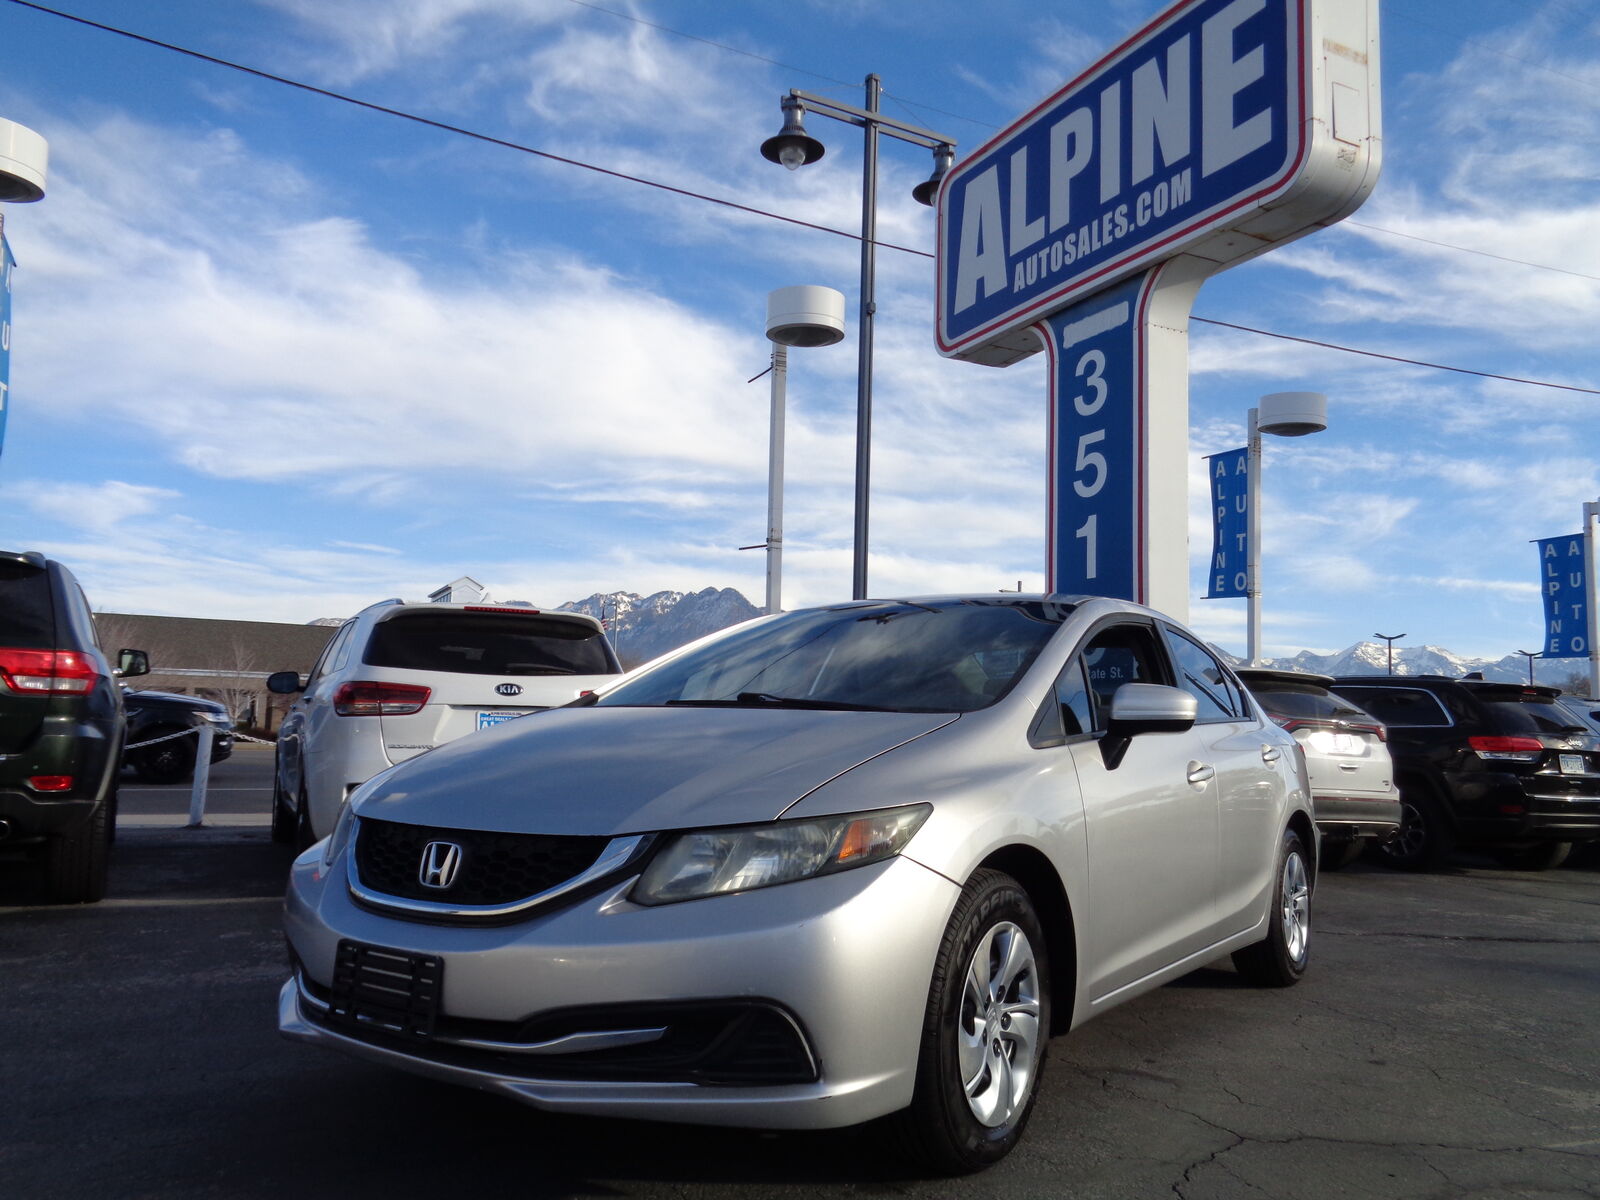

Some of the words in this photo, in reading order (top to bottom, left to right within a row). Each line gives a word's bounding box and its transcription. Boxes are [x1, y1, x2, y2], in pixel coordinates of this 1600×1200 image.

[954, 0, 1272, 315] ALPINE
[1013, 168, 1192, 293] AUTOSALES.COM
[1215, 460, 1227, 592] ALPINE
[1234, 455, 1248, 591] AUTO
[1545, 543, 1562, 653] ALPINE
[1568, 540, 1585, 653] AUTO
[1110, 666, 1124, 679] St.
